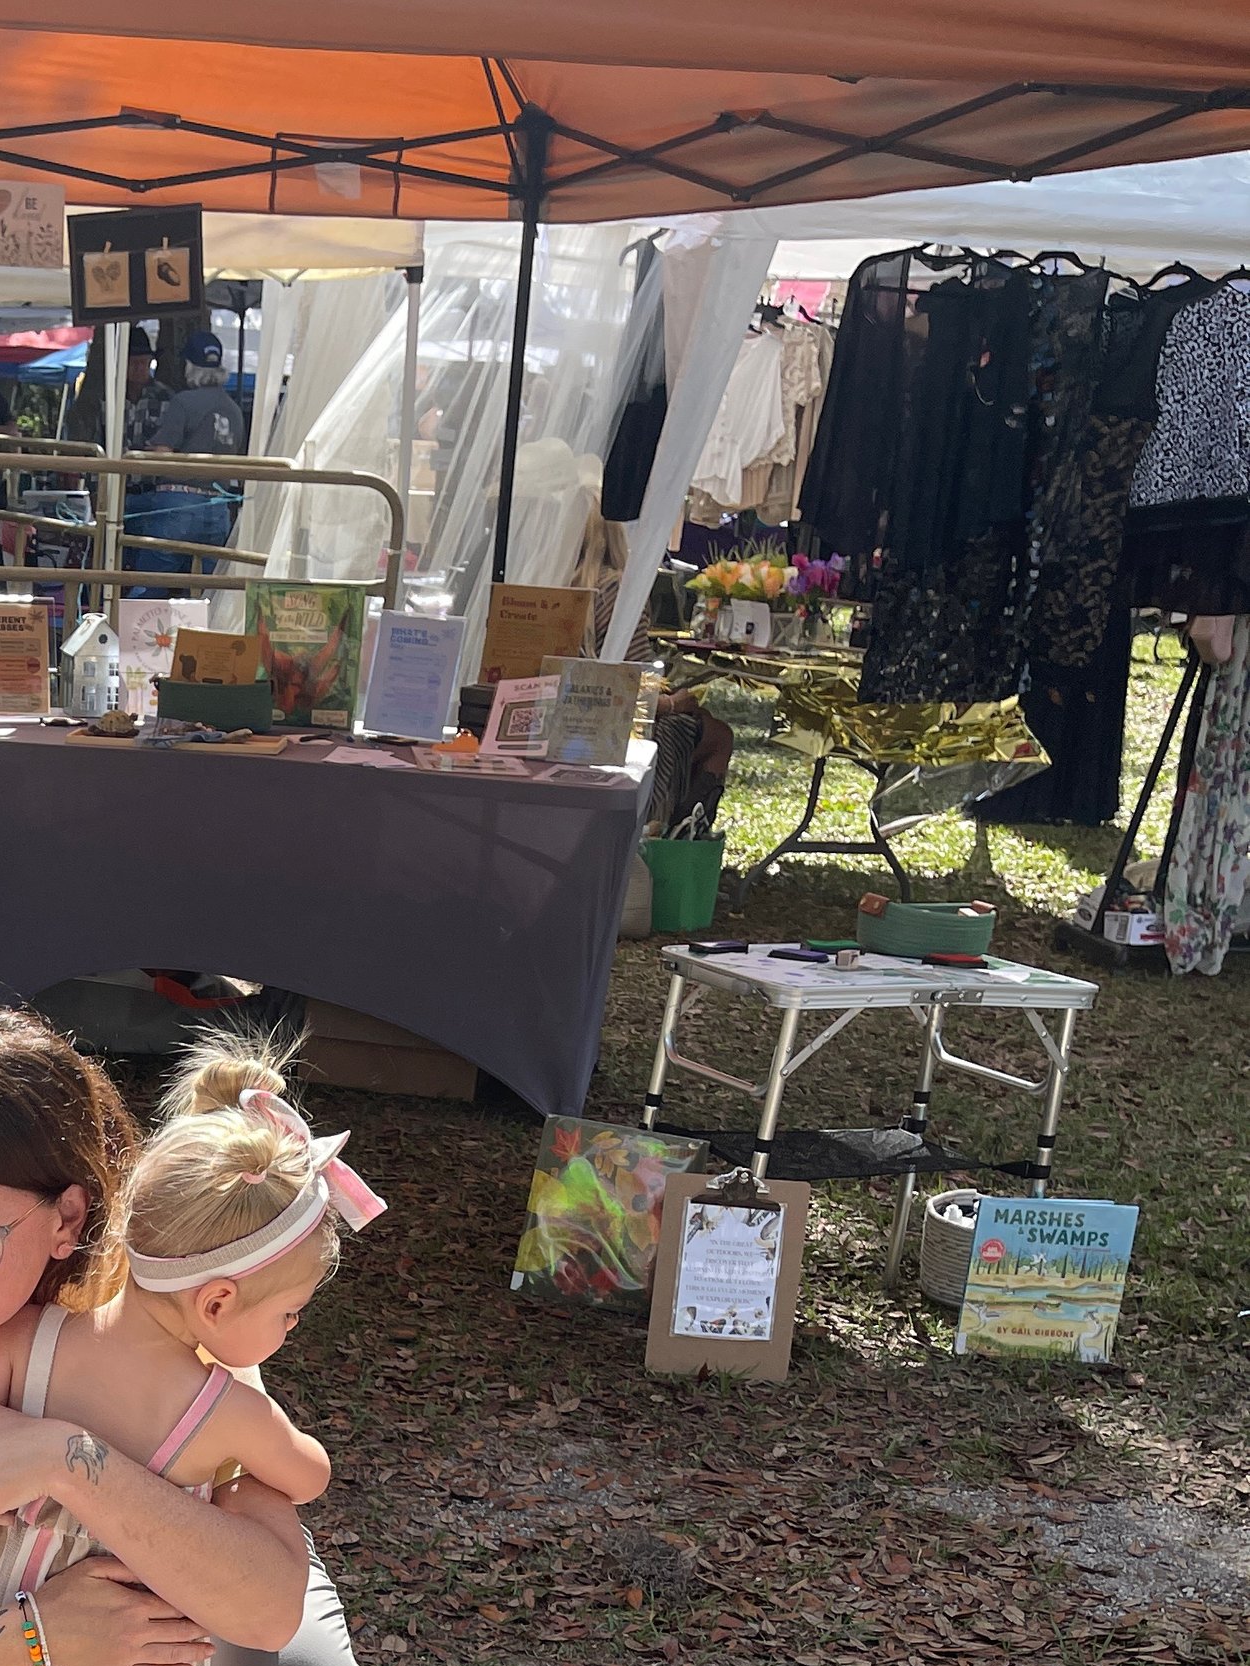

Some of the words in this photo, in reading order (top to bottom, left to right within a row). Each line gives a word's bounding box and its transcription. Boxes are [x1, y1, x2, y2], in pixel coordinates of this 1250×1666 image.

[25, 197, 38, 210] BE
[514, 683, 540, 691] SCAN
[994, 1208, 1085, 1228] MARSHES
[1027, 1228, 1109, 1247] SWAMPS
[997, 1326, 1008, 1334] BY
[1012, 1327, 1031, 1335] GAIL
[1035, 1329, 1074, 1338] GIBBONS
